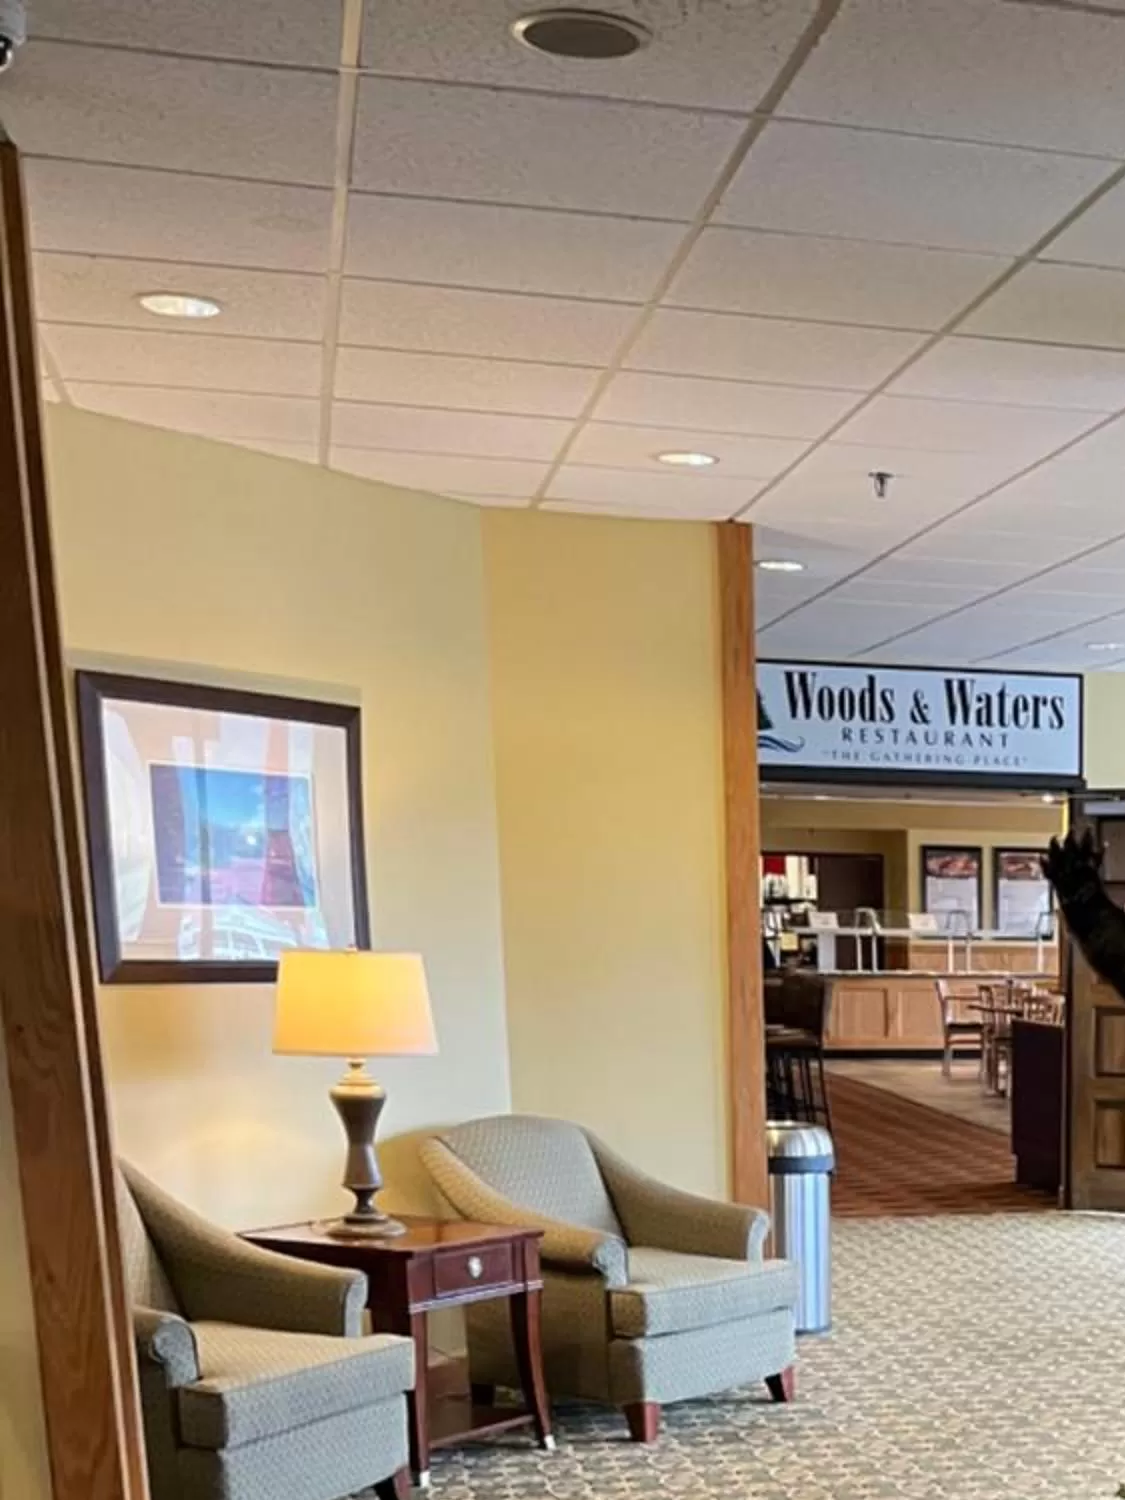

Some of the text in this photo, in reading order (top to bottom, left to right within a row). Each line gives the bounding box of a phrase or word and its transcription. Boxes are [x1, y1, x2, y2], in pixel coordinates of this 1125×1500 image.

[784, 671, 1065, 730] Woods & Waters
[841, 727, 1008, 748] RESTAURANT
[869, 751, 964, 765] GATHERING
